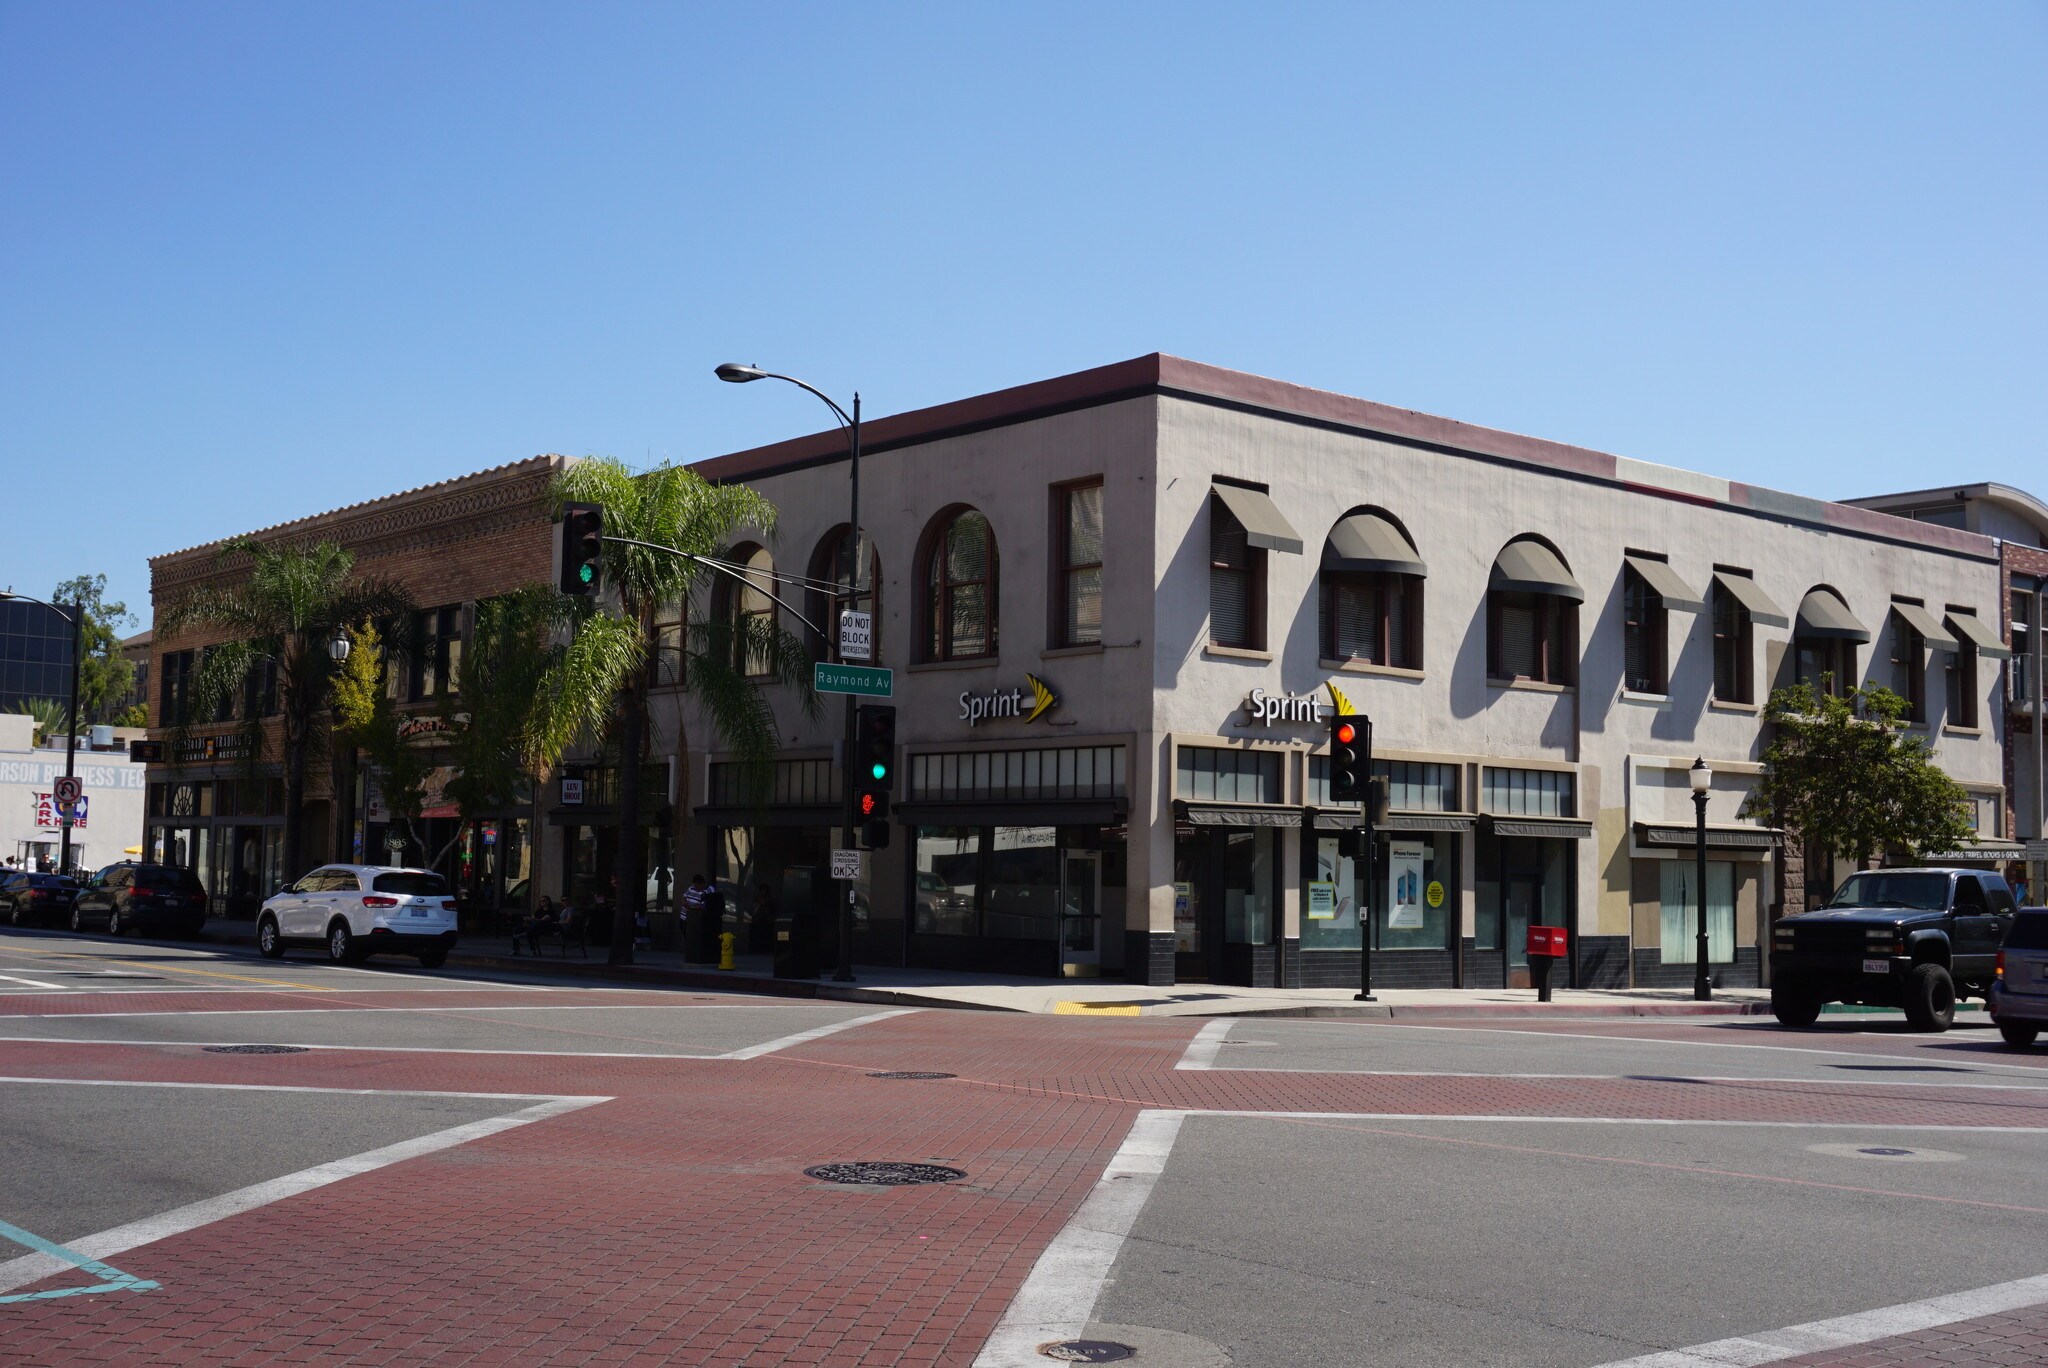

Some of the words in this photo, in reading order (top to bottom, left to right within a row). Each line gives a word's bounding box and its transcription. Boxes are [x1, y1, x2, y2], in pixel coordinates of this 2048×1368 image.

[842, 617, 853, 628] DO
[855, 617, 869, 629] NOT
[842, 632, 869, 644] BLOCK
[841, 645, 869, 655] INTERSECTION
[818, 672, 870, 686] Raymond
[876, 677, 889, 688] Av
[959, 687, 1021, 727] Sprint
[1251, 688, 1321, 727] Sprint
[44, 764, 115, 786] BUINESS
[38, 793, 52, 826] PARK
[54, 817, 87, 828] HRE
[834, 866, 844, 876] OK
